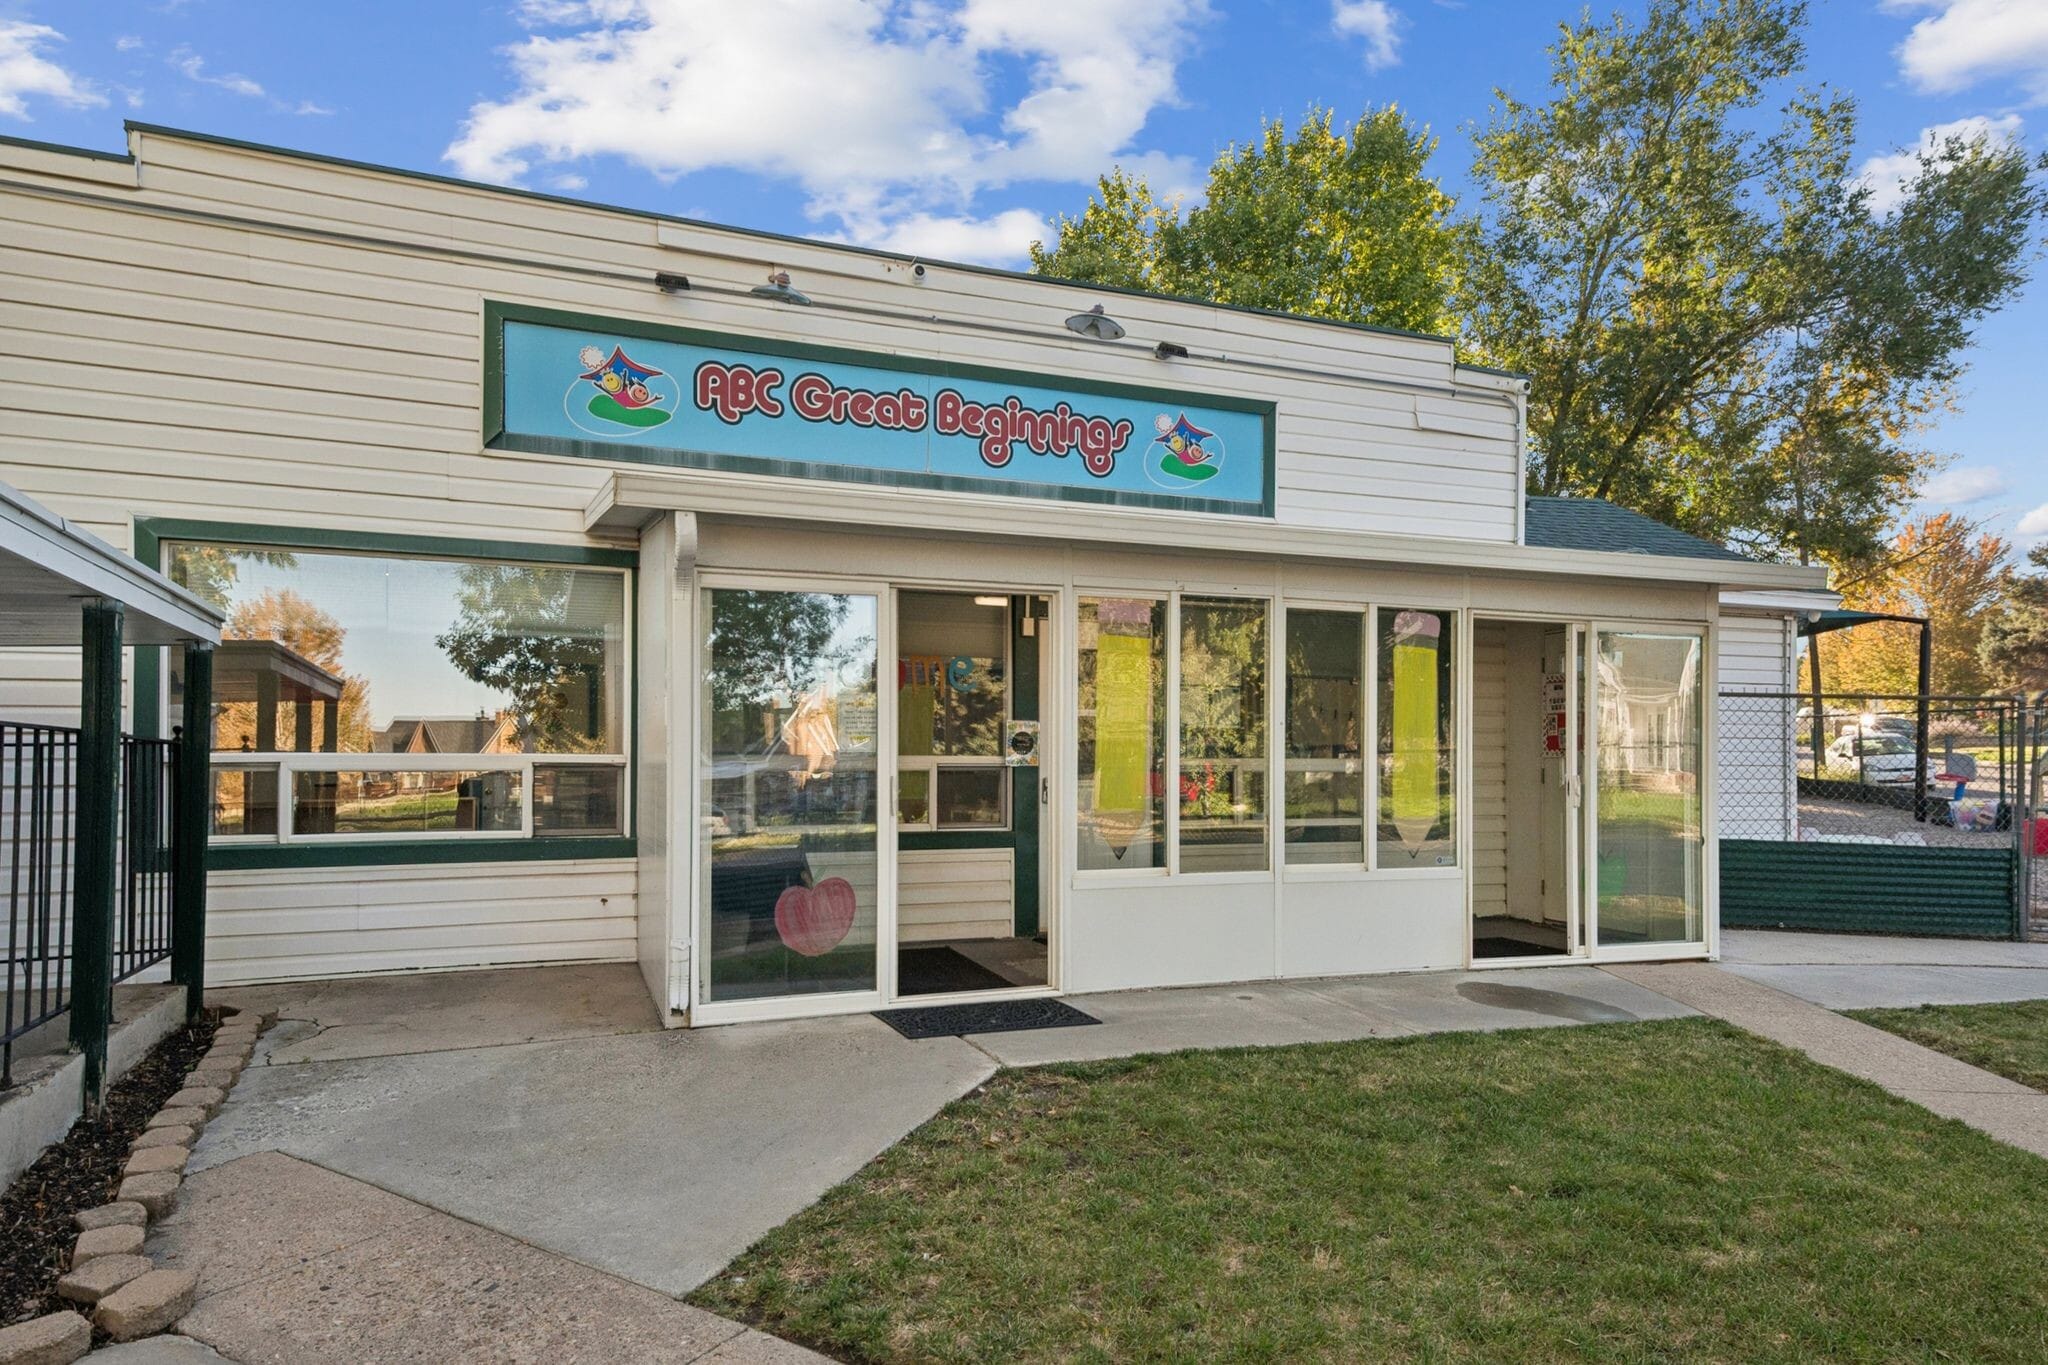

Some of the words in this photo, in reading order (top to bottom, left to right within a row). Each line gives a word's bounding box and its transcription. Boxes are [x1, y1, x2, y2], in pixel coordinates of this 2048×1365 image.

[694, 360, 785, 425] ABC
[790, 373, 929, 432] Great
[934, 387, 1134, 478] Beginnings
